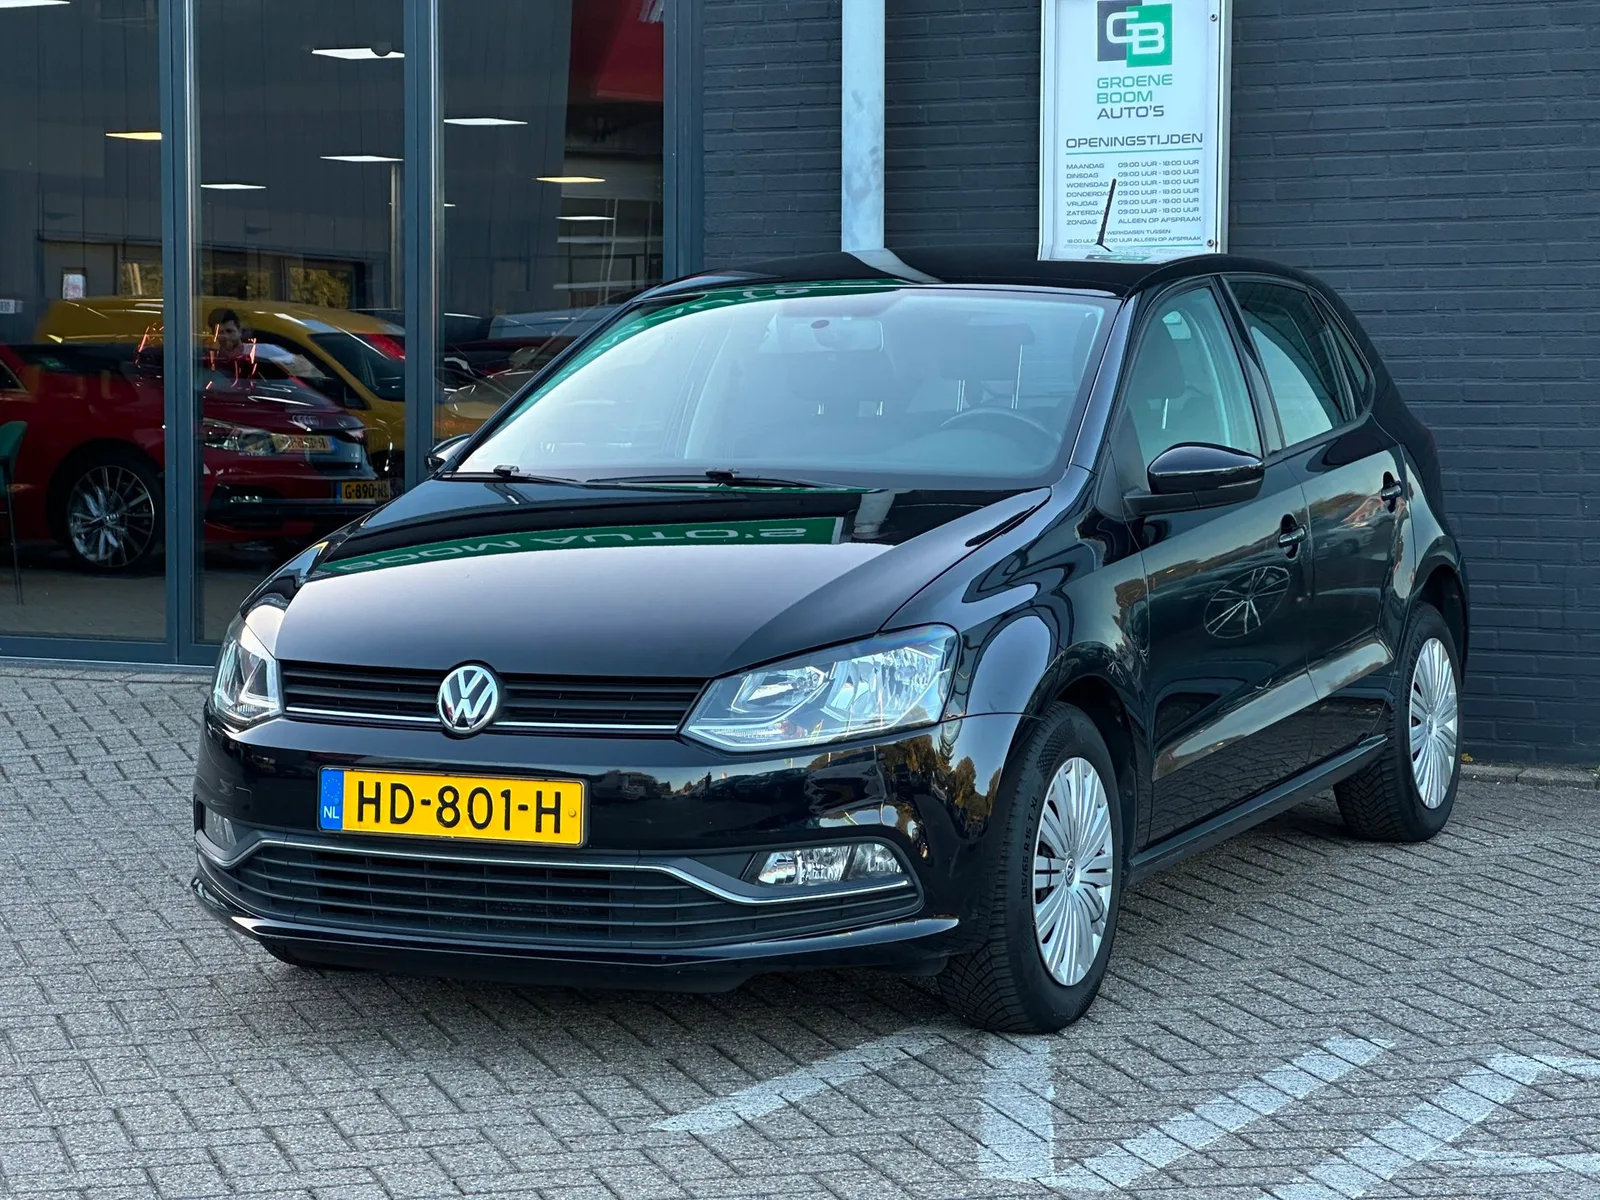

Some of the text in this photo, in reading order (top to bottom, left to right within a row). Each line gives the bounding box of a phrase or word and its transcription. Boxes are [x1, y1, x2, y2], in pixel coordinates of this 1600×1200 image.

[1097, 74, 1173, 89] GROENE
[1097, 90, 1153, 105] BOOM
[1097, 105, 1165, 120] AUTO'S
[1066, 133, 1203, 149] OPENINGSTIJDEN
[323, 805, 340, 820] NL
[357, 780, 561, 834] HD-801-H
